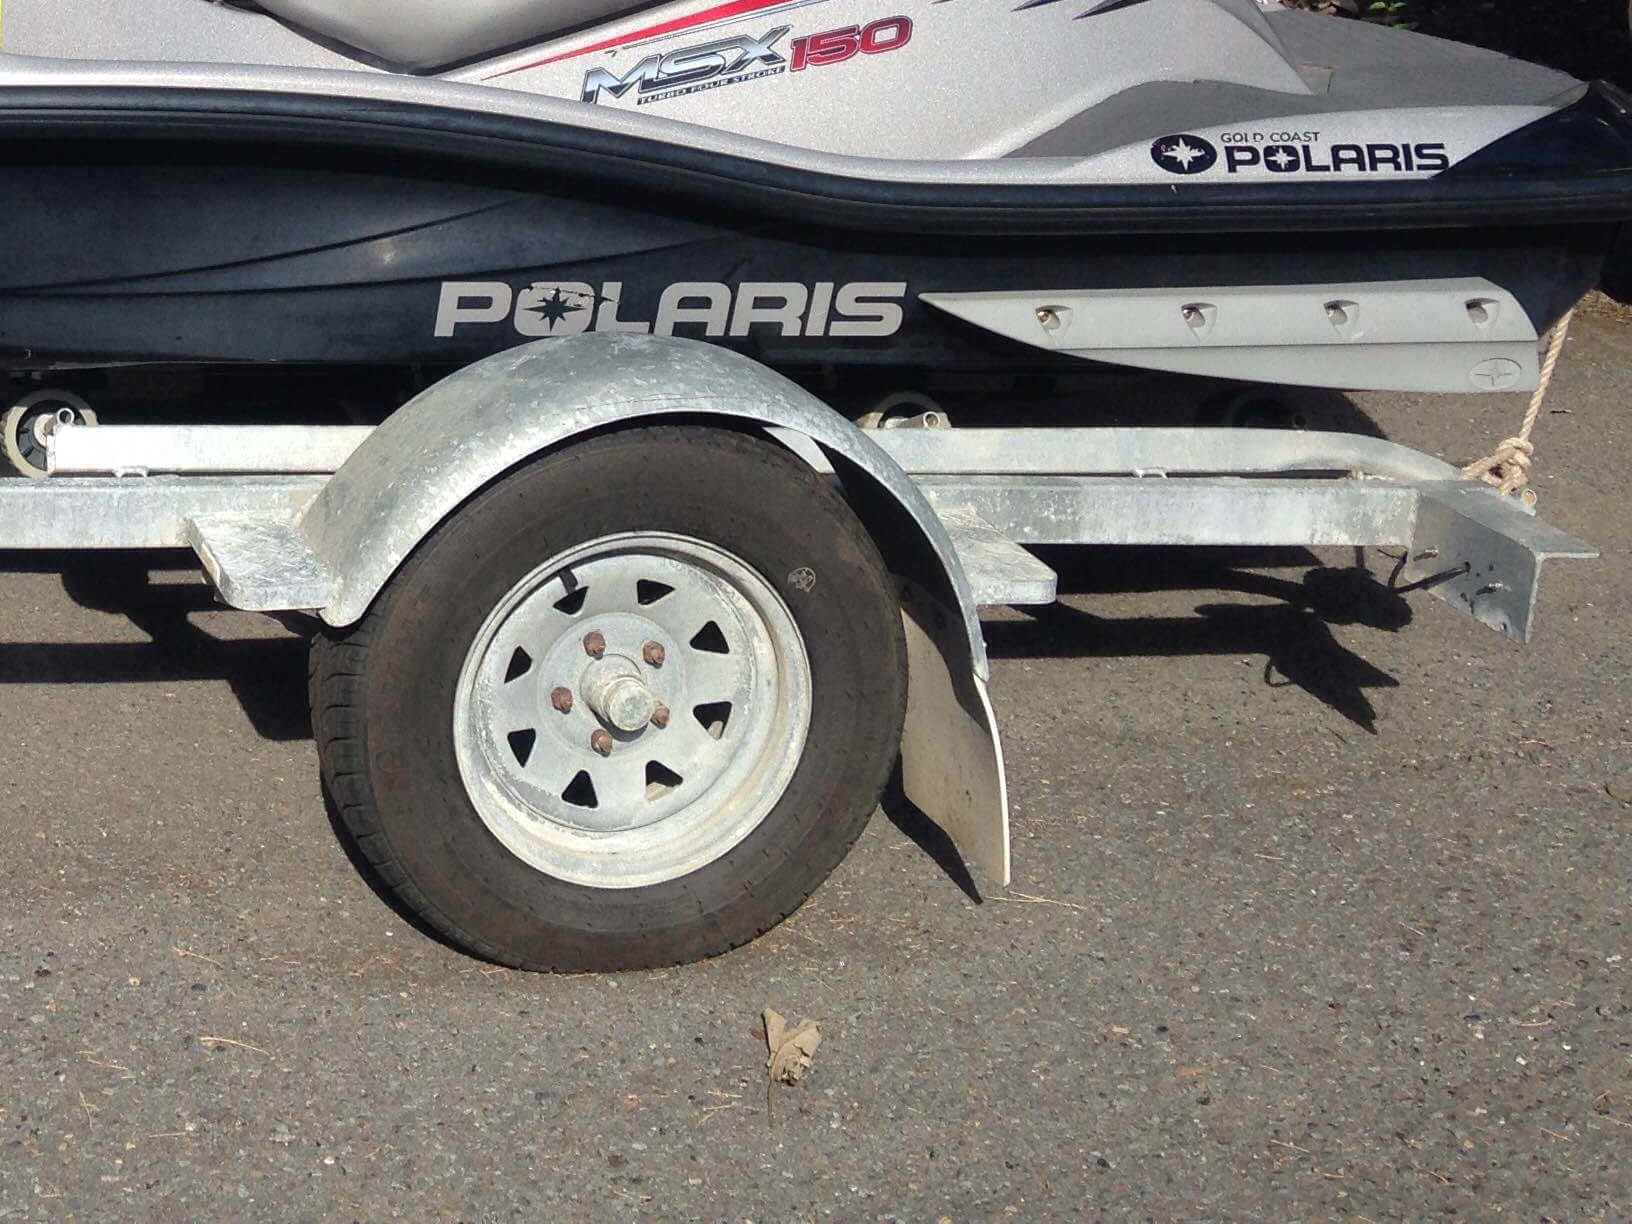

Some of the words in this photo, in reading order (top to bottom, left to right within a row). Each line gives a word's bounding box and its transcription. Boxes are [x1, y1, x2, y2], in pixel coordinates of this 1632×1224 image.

[580, 24, 794, 105] MSX
[789, 15, 914, 73] 150
[1224, 142, 1449, 173] POLARIS
[1270, 131, 1320, 143] COAST
[434, 281, 907, 337] POLARIS
